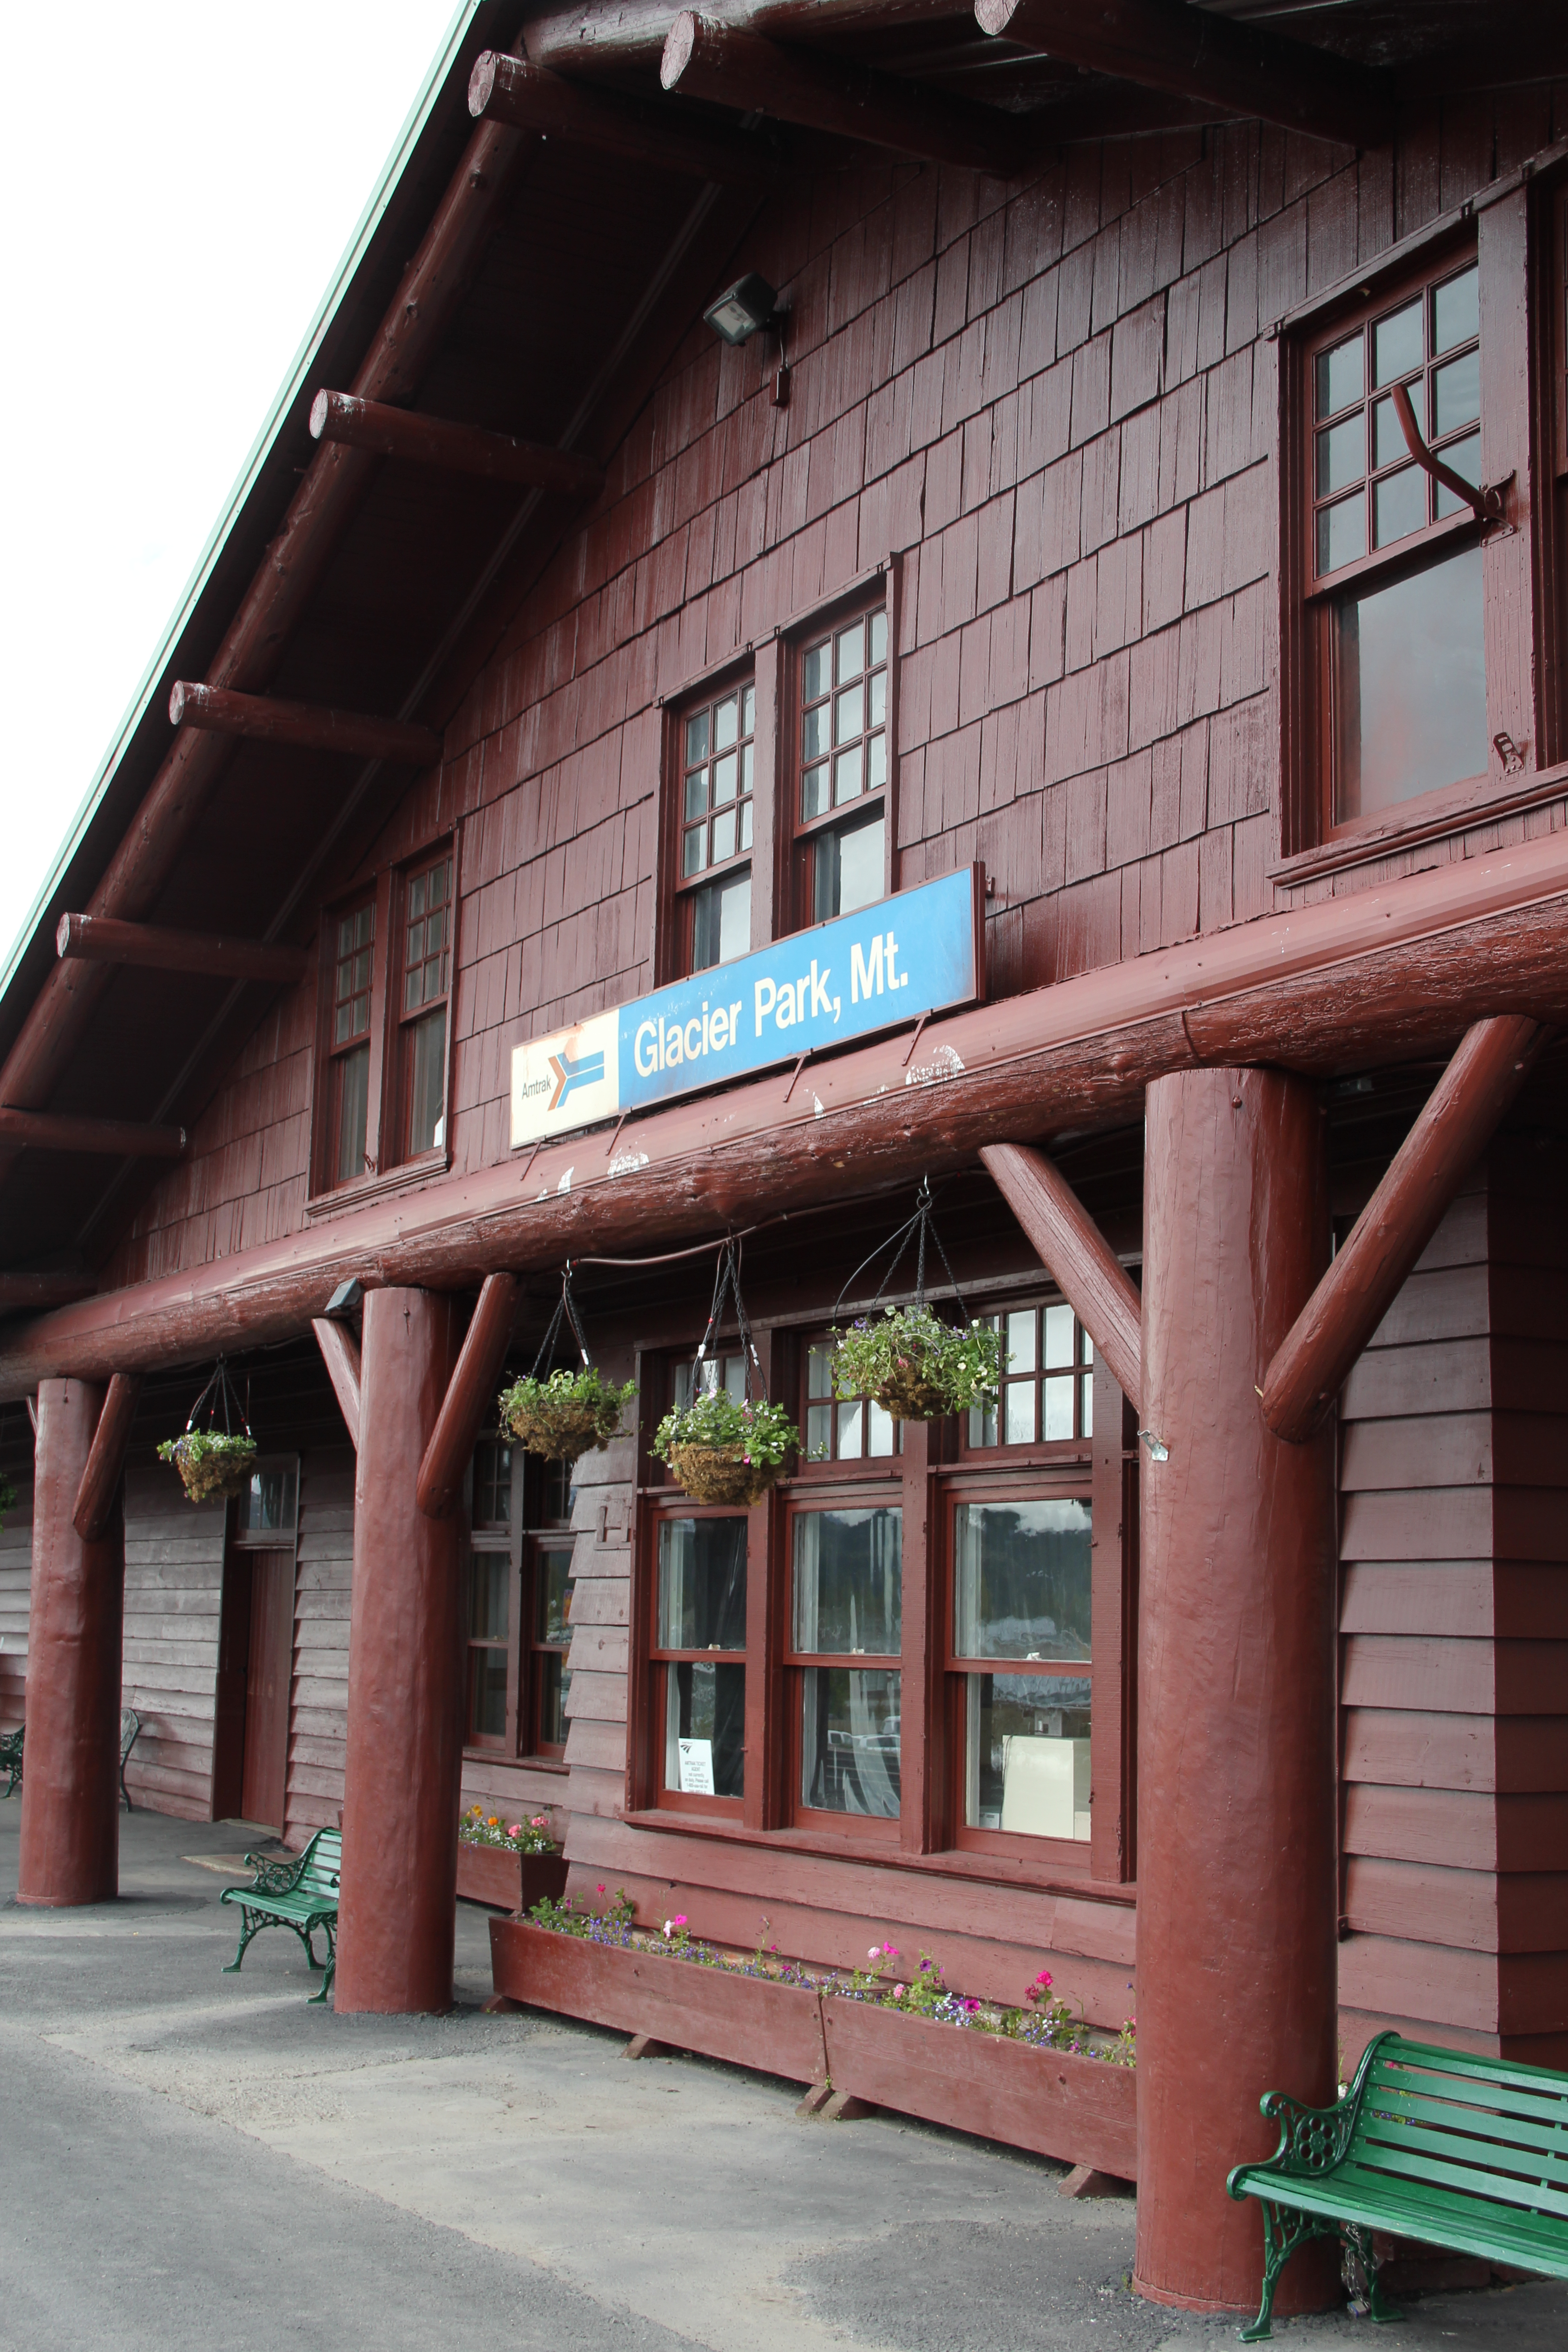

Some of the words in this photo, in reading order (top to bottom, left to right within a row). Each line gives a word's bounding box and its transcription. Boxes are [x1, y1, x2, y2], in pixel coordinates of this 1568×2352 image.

[634, 1000, 742, 1077] Glacier
[755, 959, 841, 1037] Park,
[850, 931, 908, 1004] Mt.
[522, 1074, 551, 1100] Amtrak
